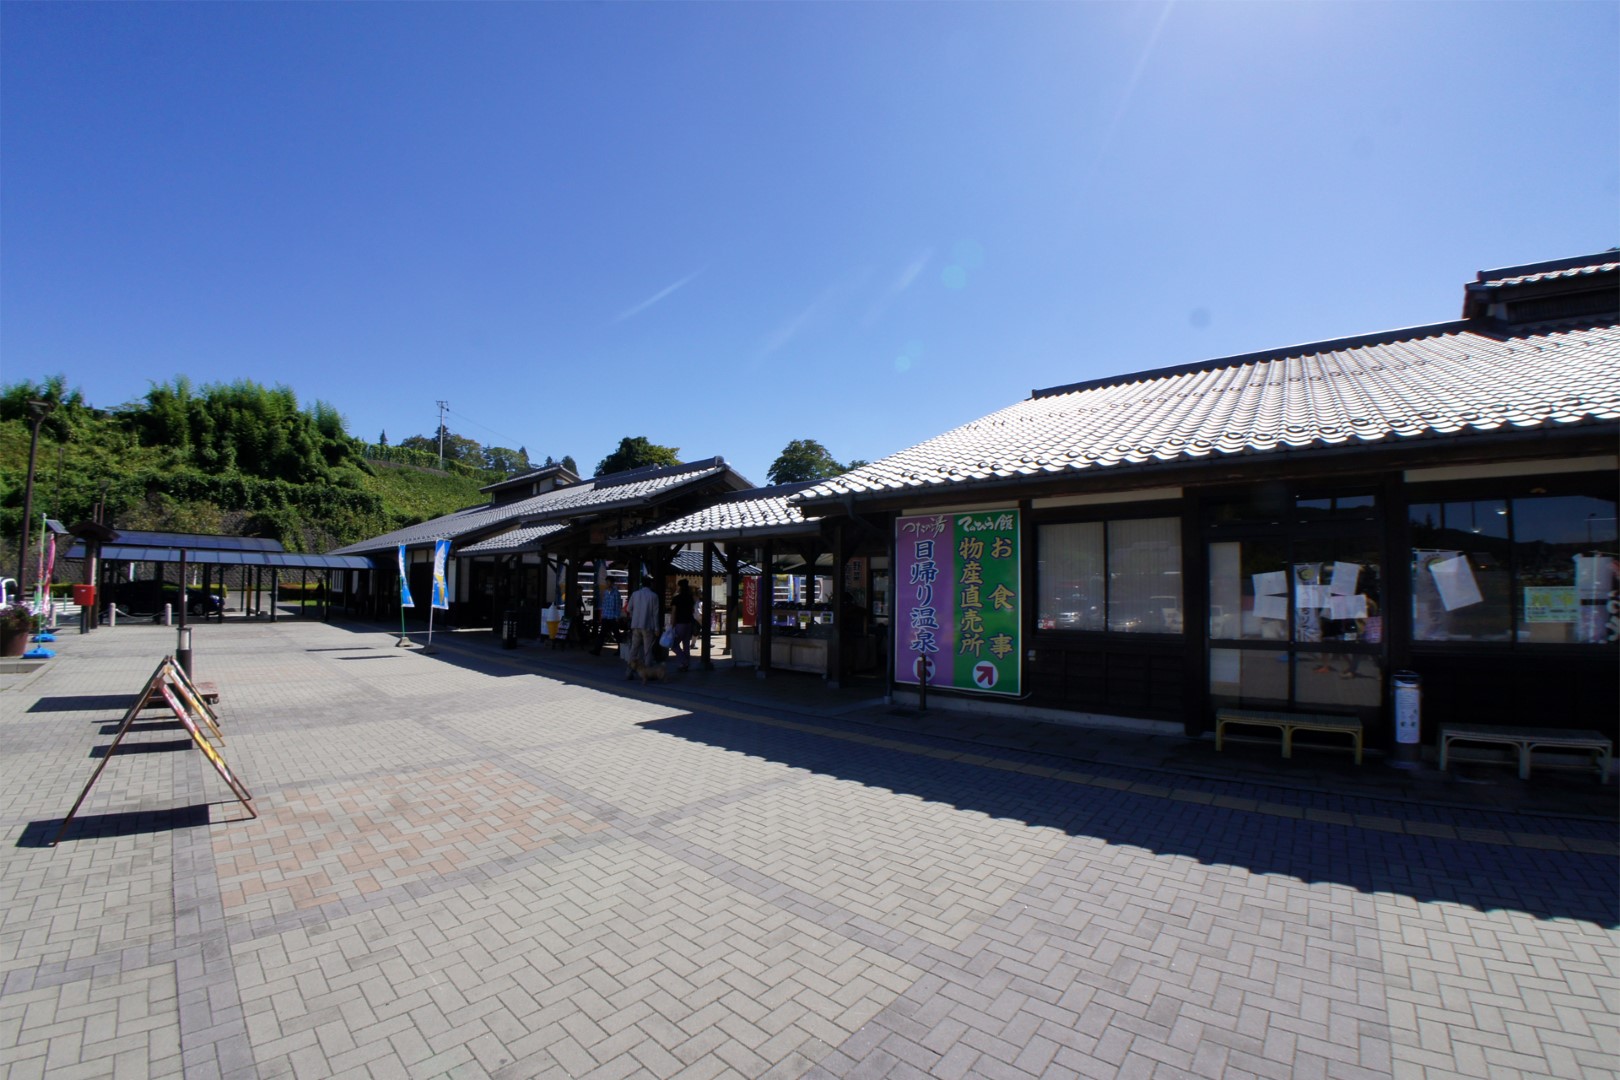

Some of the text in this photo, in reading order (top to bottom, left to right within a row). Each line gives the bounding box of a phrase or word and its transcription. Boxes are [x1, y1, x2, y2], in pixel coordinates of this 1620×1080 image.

[910, 539, 939, 653] 日帰り温泉
[959, 537, 985, 659] 物産直売所
[988, 537, 1016, 661] お食事
